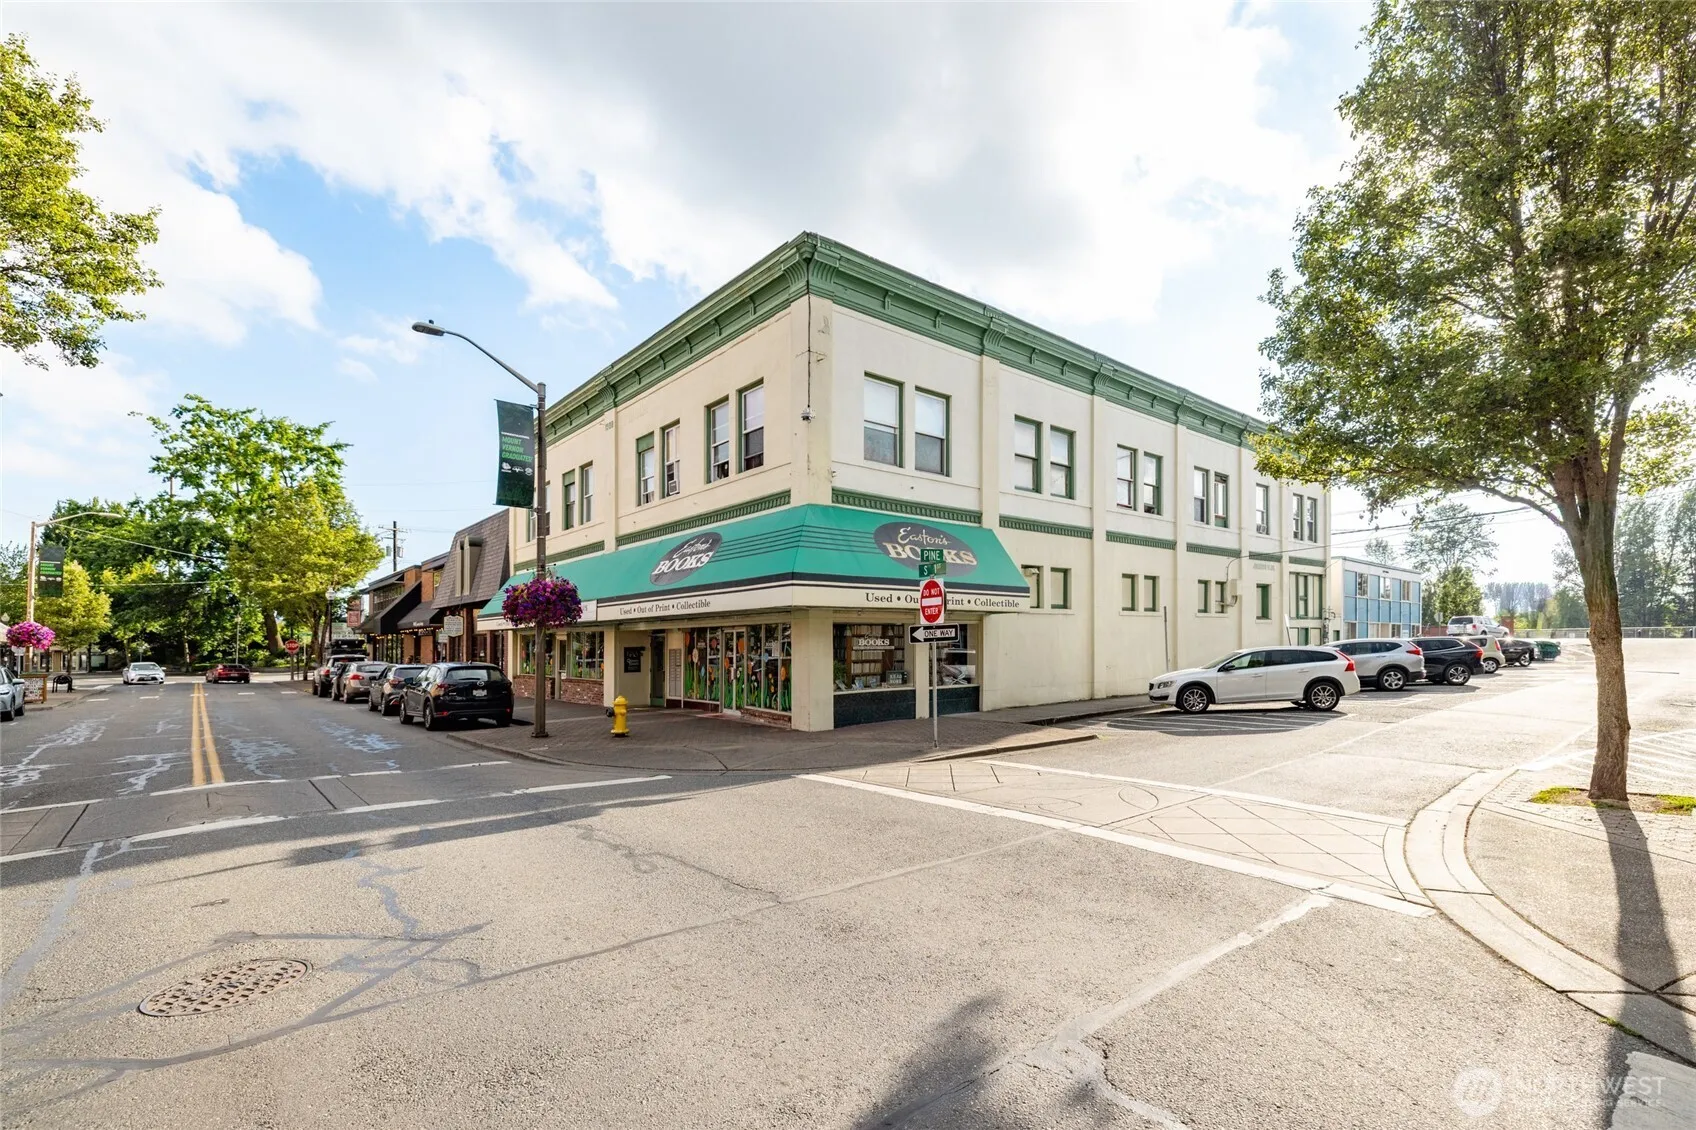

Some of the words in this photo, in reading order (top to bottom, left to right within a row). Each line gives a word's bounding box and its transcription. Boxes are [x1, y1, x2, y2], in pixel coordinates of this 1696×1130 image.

[897, 526, 952, 545] Easton's
[882, 542, 978, 566] BOKS
[923, 550, 940, 560] PINE
[651, 551, 714, 575] BOOKS
[923, 565, 928, 575] S
[931, 587, 940, 595] NOT
[865, 592, 893, 603] Used
[904, 594, 919, 604] Ou
[946, 596, 964, 606] rint
[974, 597, 1020, 608] Collectible
[620, 607, 632, 615] Used
[637, 605, 647, 613] Out
[648, 604, 654, 612] of
[655, 603, 670, 612] Print
[676, 599, 711, 610] Collectible
[925, 607, 939, 615] ENTER
[924, 629, 937, 638] ONE
[940, 629, 953, 637] WAY
[858, 638, 890, 646] BOOKS
